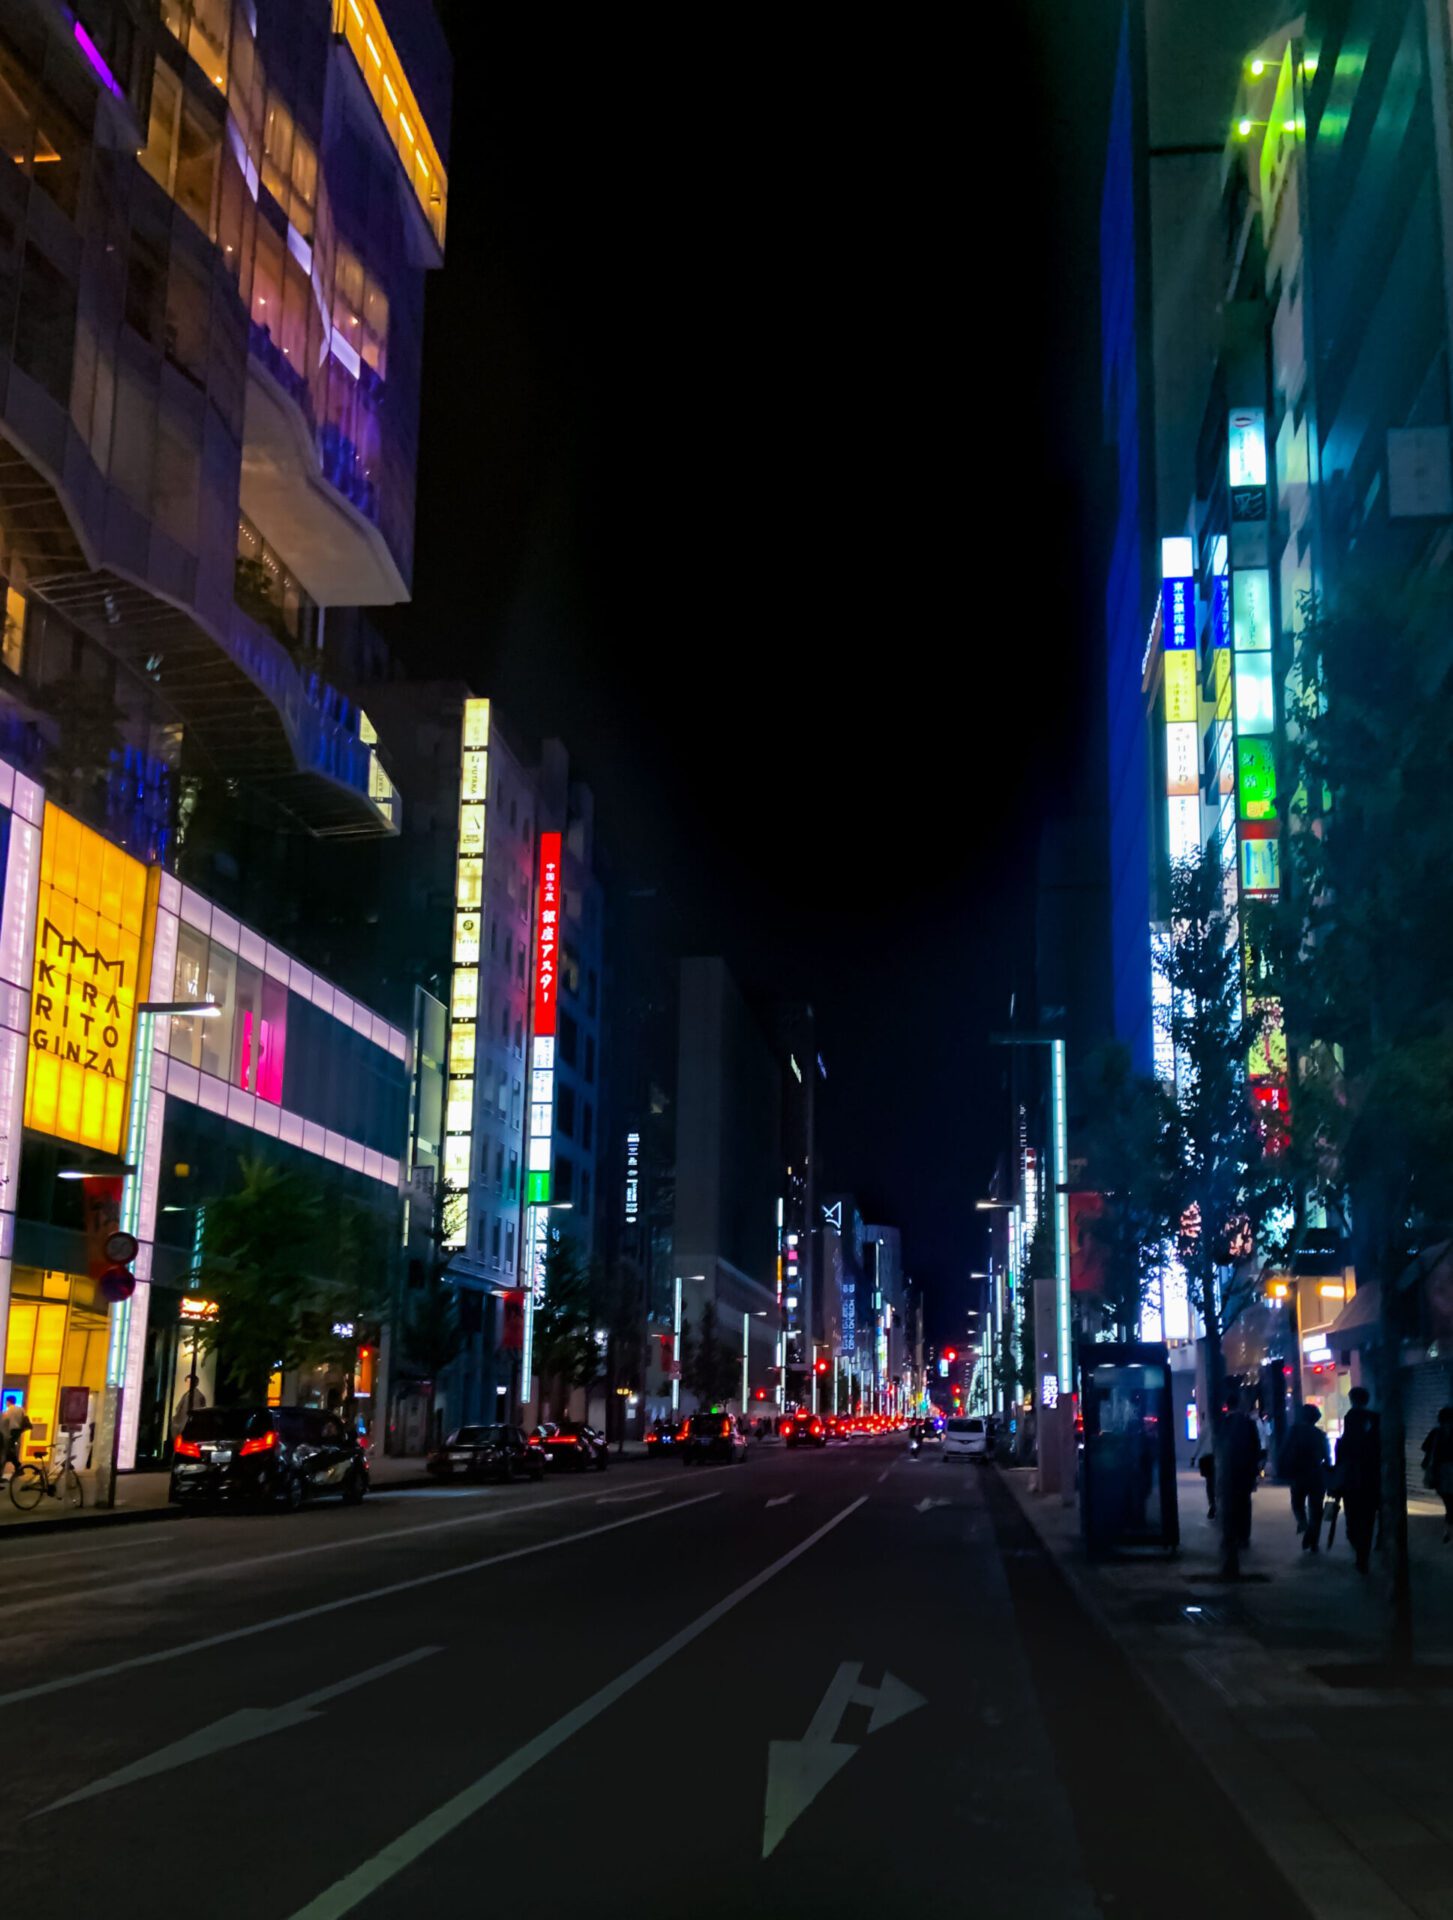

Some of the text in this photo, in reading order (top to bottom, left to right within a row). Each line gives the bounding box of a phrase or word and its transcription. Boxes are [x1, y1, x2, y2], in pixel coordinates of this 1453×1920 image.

[540, 909, 556, 1003] 銀座アスター
[39, 959, 120, 1019] KIRA
[35, 993, 119, 1048] RITO
[33, 1029, 116, 1079] GINZA
